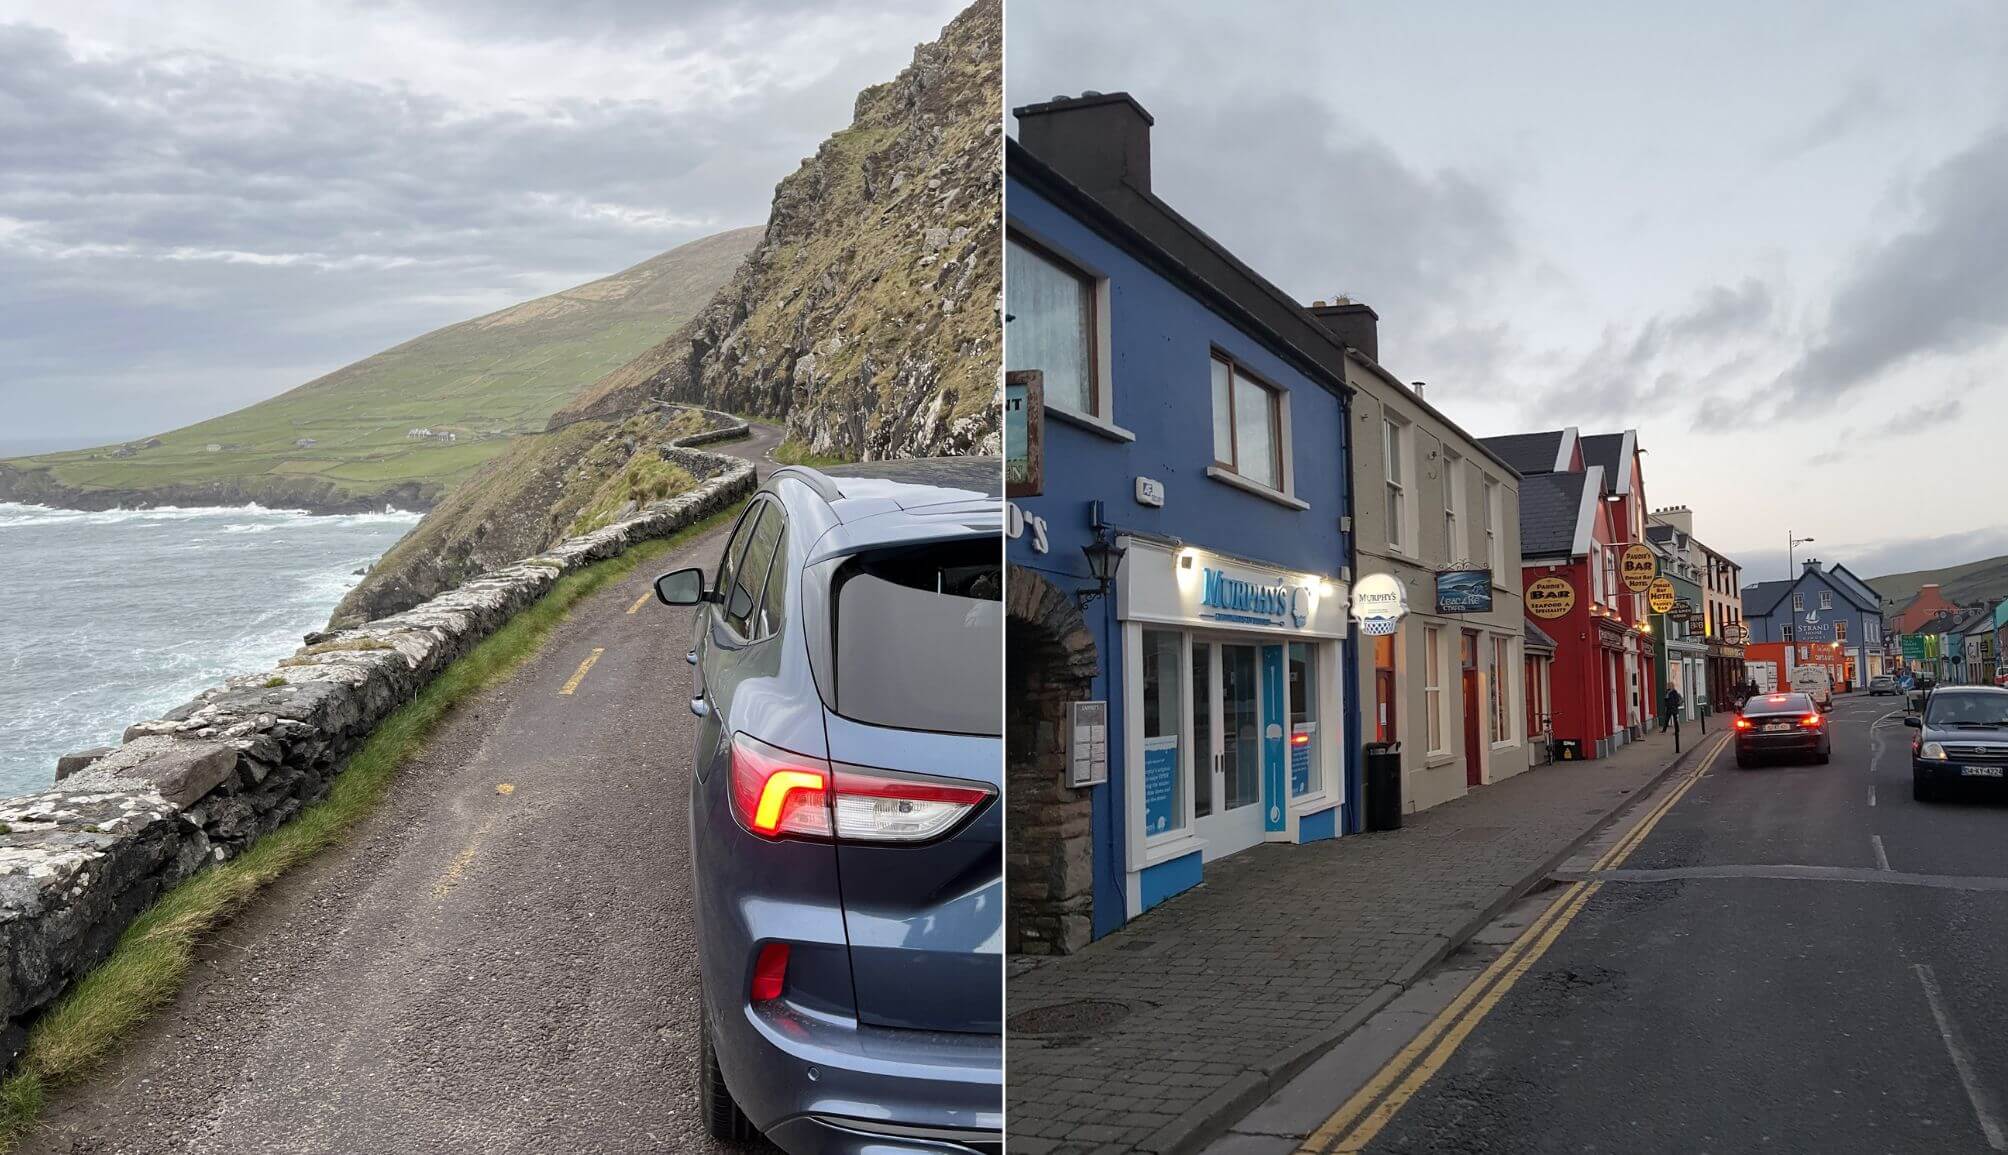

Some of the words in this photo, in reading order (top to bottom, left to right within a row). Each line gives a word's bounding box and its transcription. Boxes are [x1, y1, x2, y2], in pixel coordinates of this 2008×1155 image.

[1624, 560, 1653, 571] BAR
[1202, 567, 1287, 617] MURPHY'S
[1359, 591, 1396, 602] MURPHY'S
[1530, 590, 1570, 600] BAR
[1798, 623, 1830, 632] STRAND
